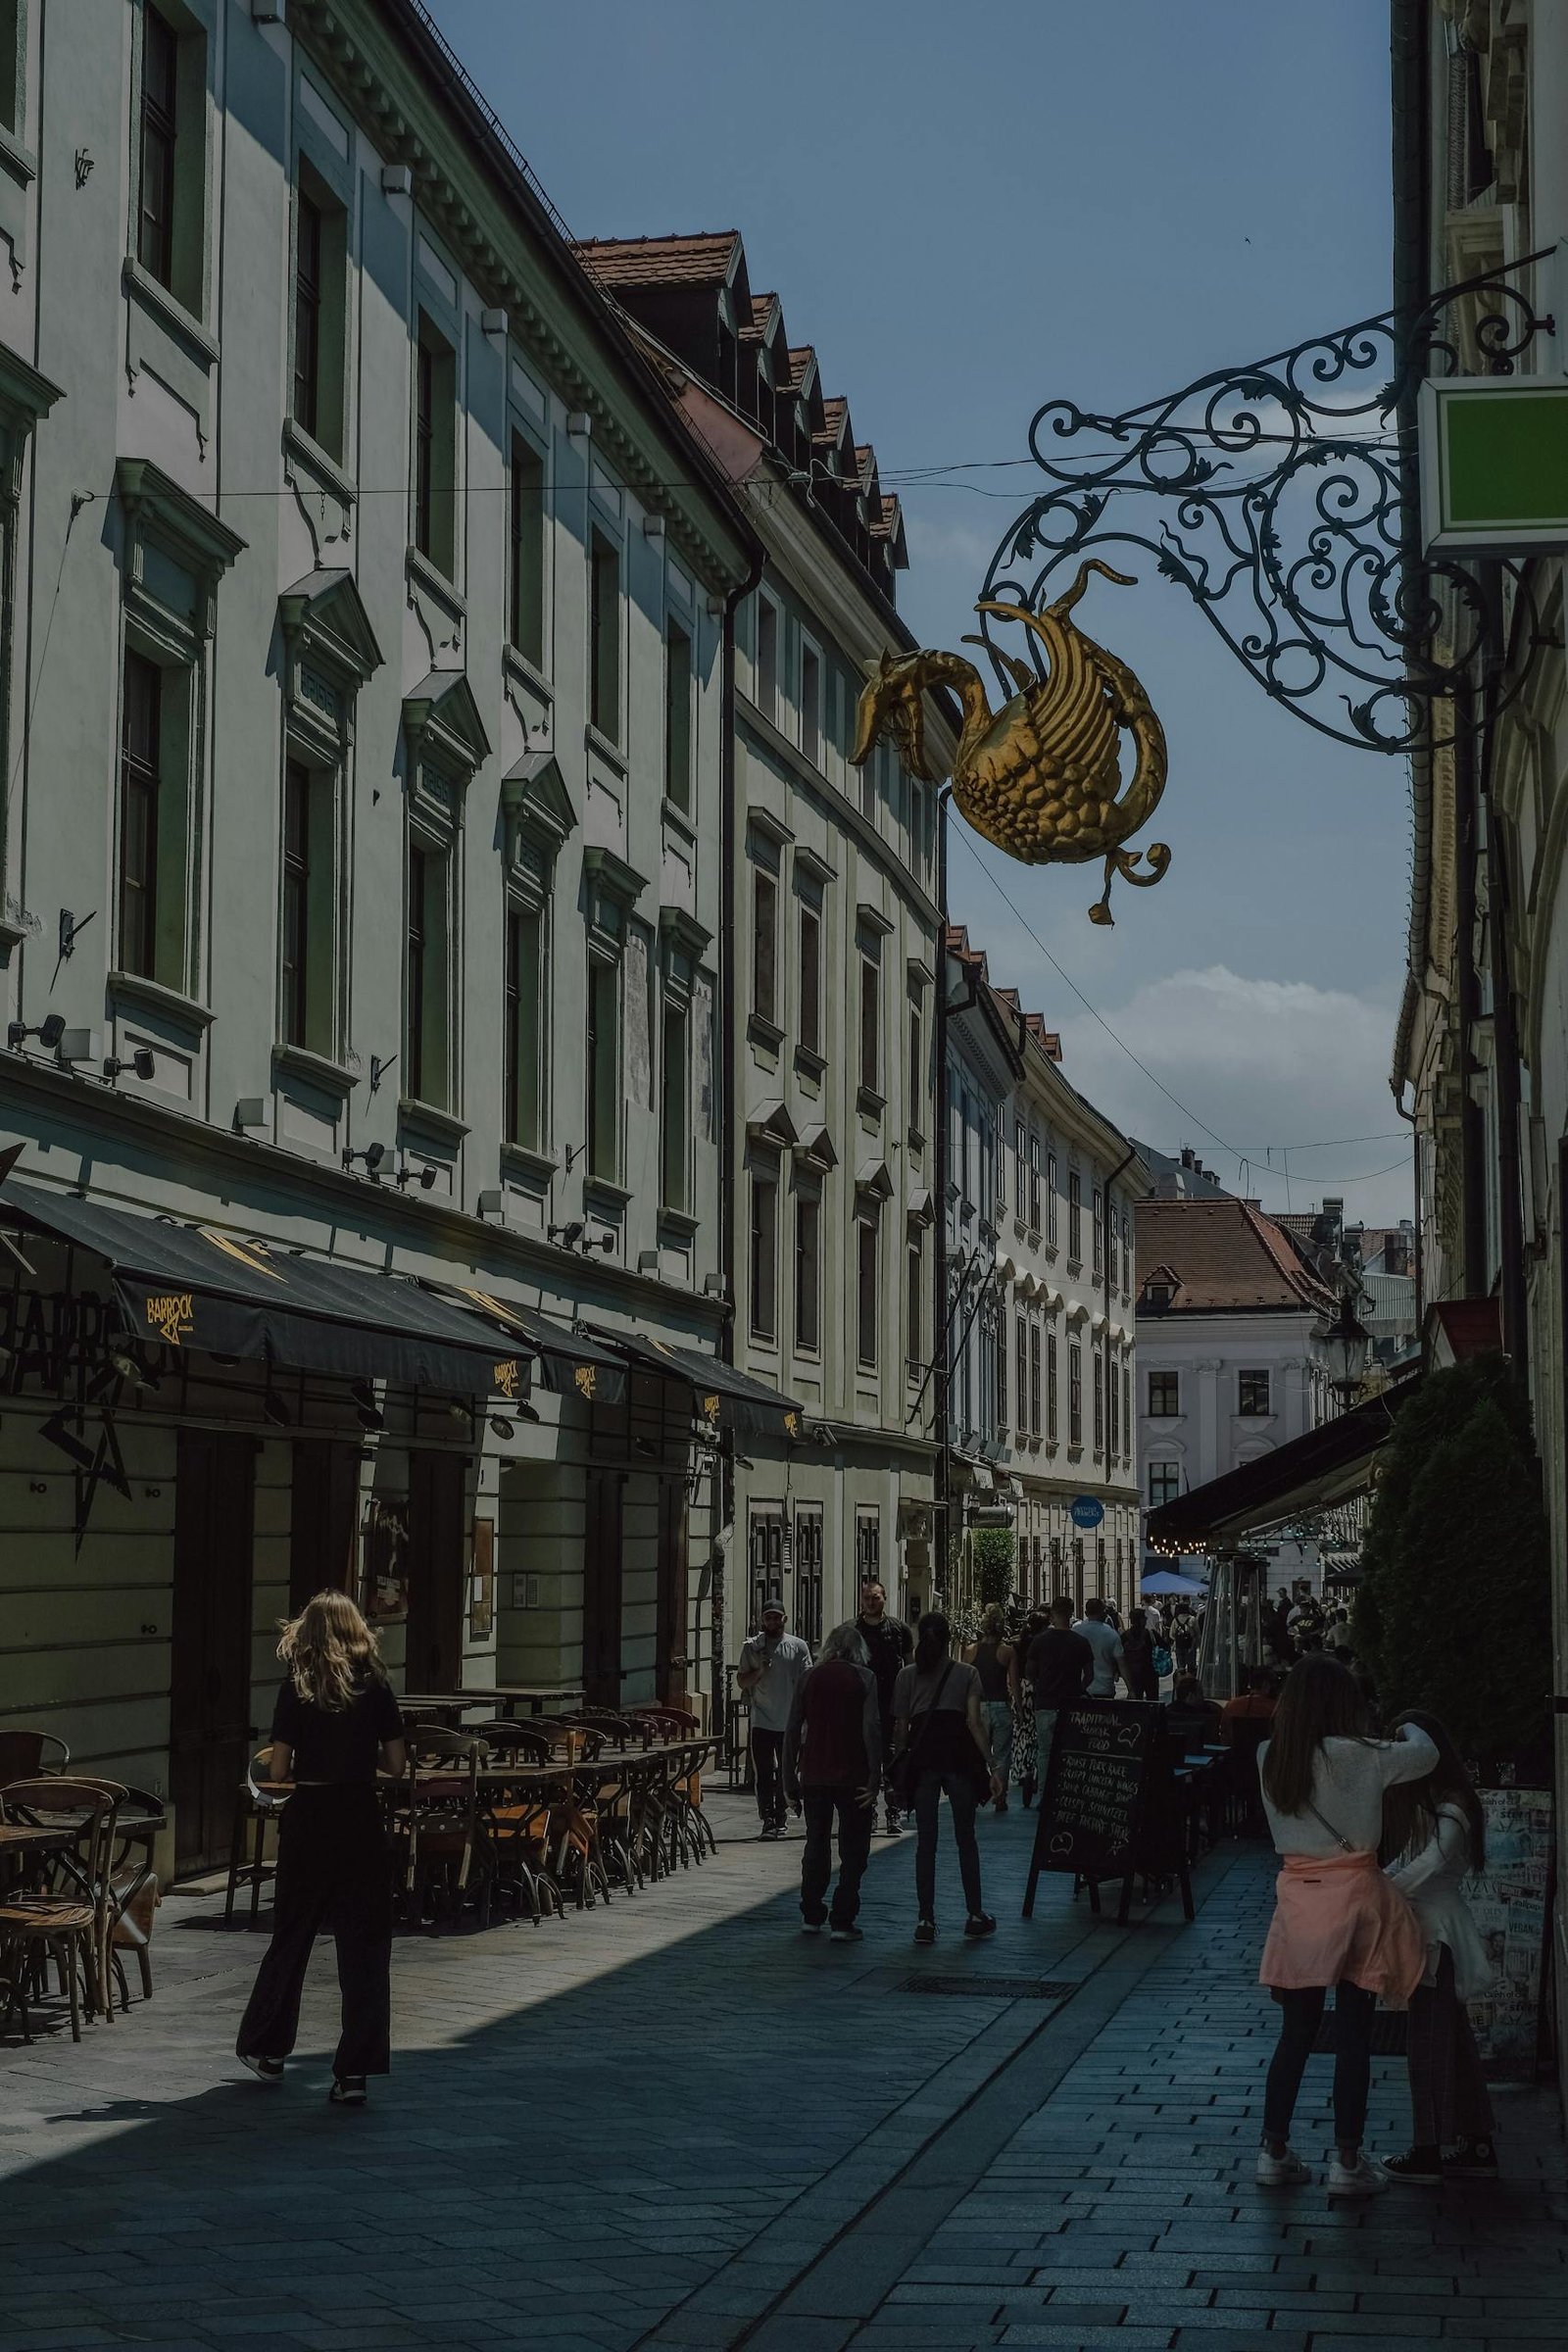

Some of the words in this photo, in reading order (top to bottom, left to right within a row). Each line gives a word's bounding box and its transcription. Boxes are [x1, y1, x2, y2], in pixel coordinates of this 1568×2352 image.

[146, 1295, 194, 1324] BARROCK
[1088, 1738, 1110, 1750] FOOD
[1509, 1922, 1534, 1934] VEGAN
